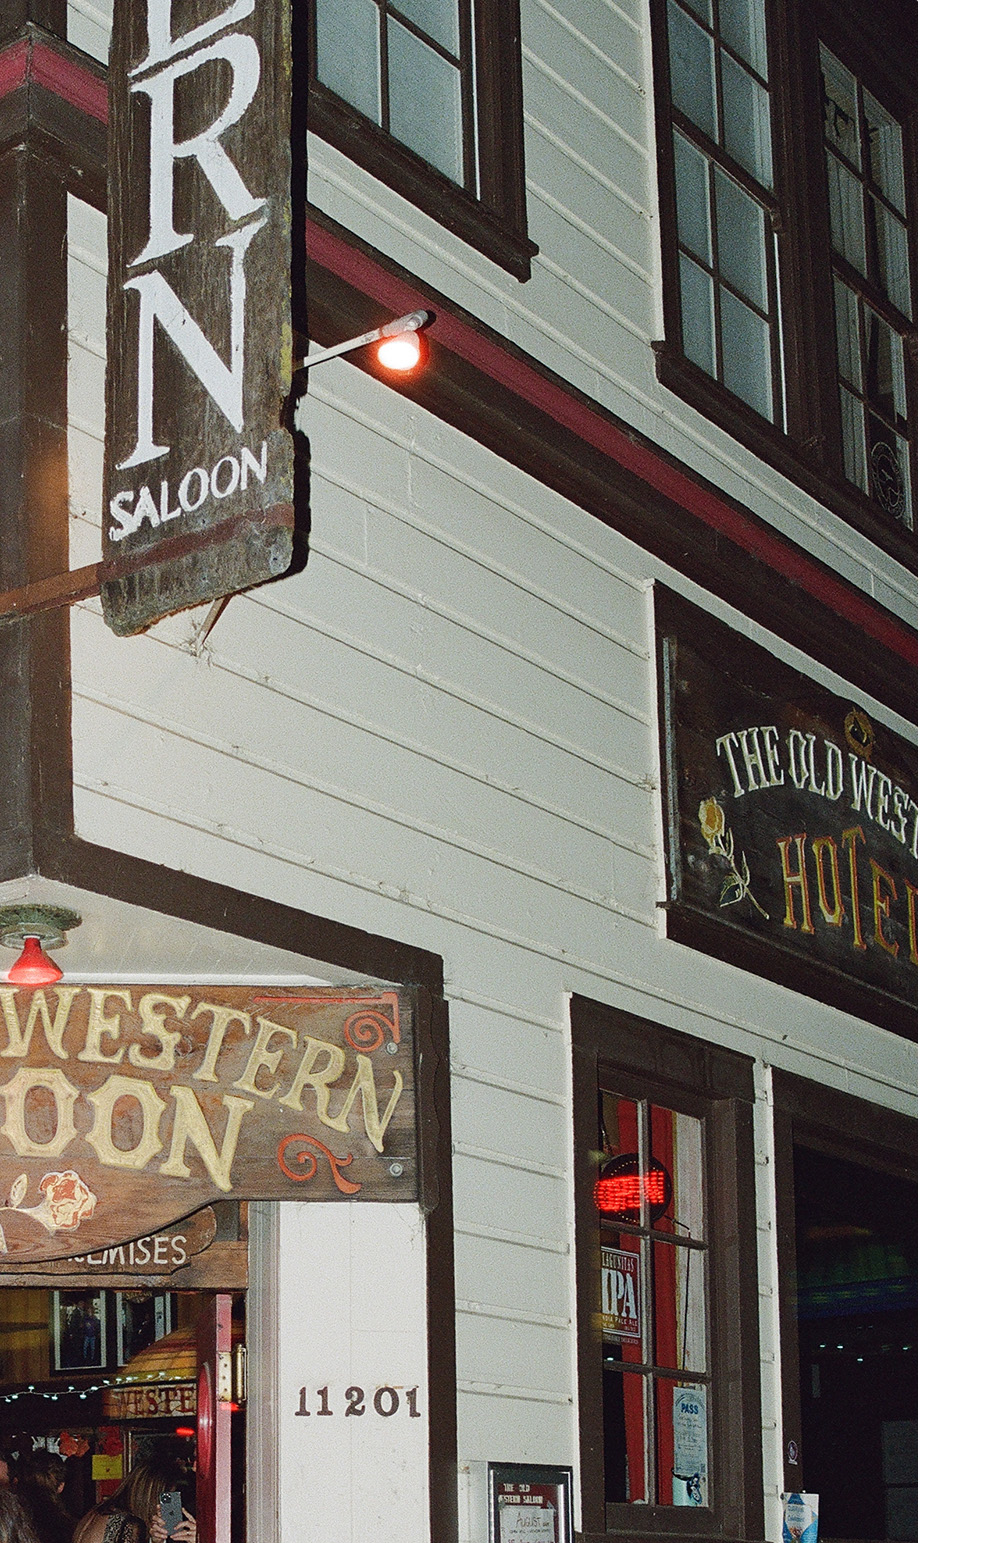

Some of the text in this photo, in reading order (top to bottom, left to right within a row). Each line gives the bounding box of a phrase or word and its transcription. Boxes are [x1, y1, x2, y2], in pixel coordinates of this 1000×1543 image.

[109, 441, 268, 541] SALOON
[715, 725, 785, 798] THE
[787, 728, 845, 801] OLD
[601, 1268, 638, 1319] IPA
[294, 1384, 422, 1418] 11201
[681, 1402, 698, 1415] PASS
